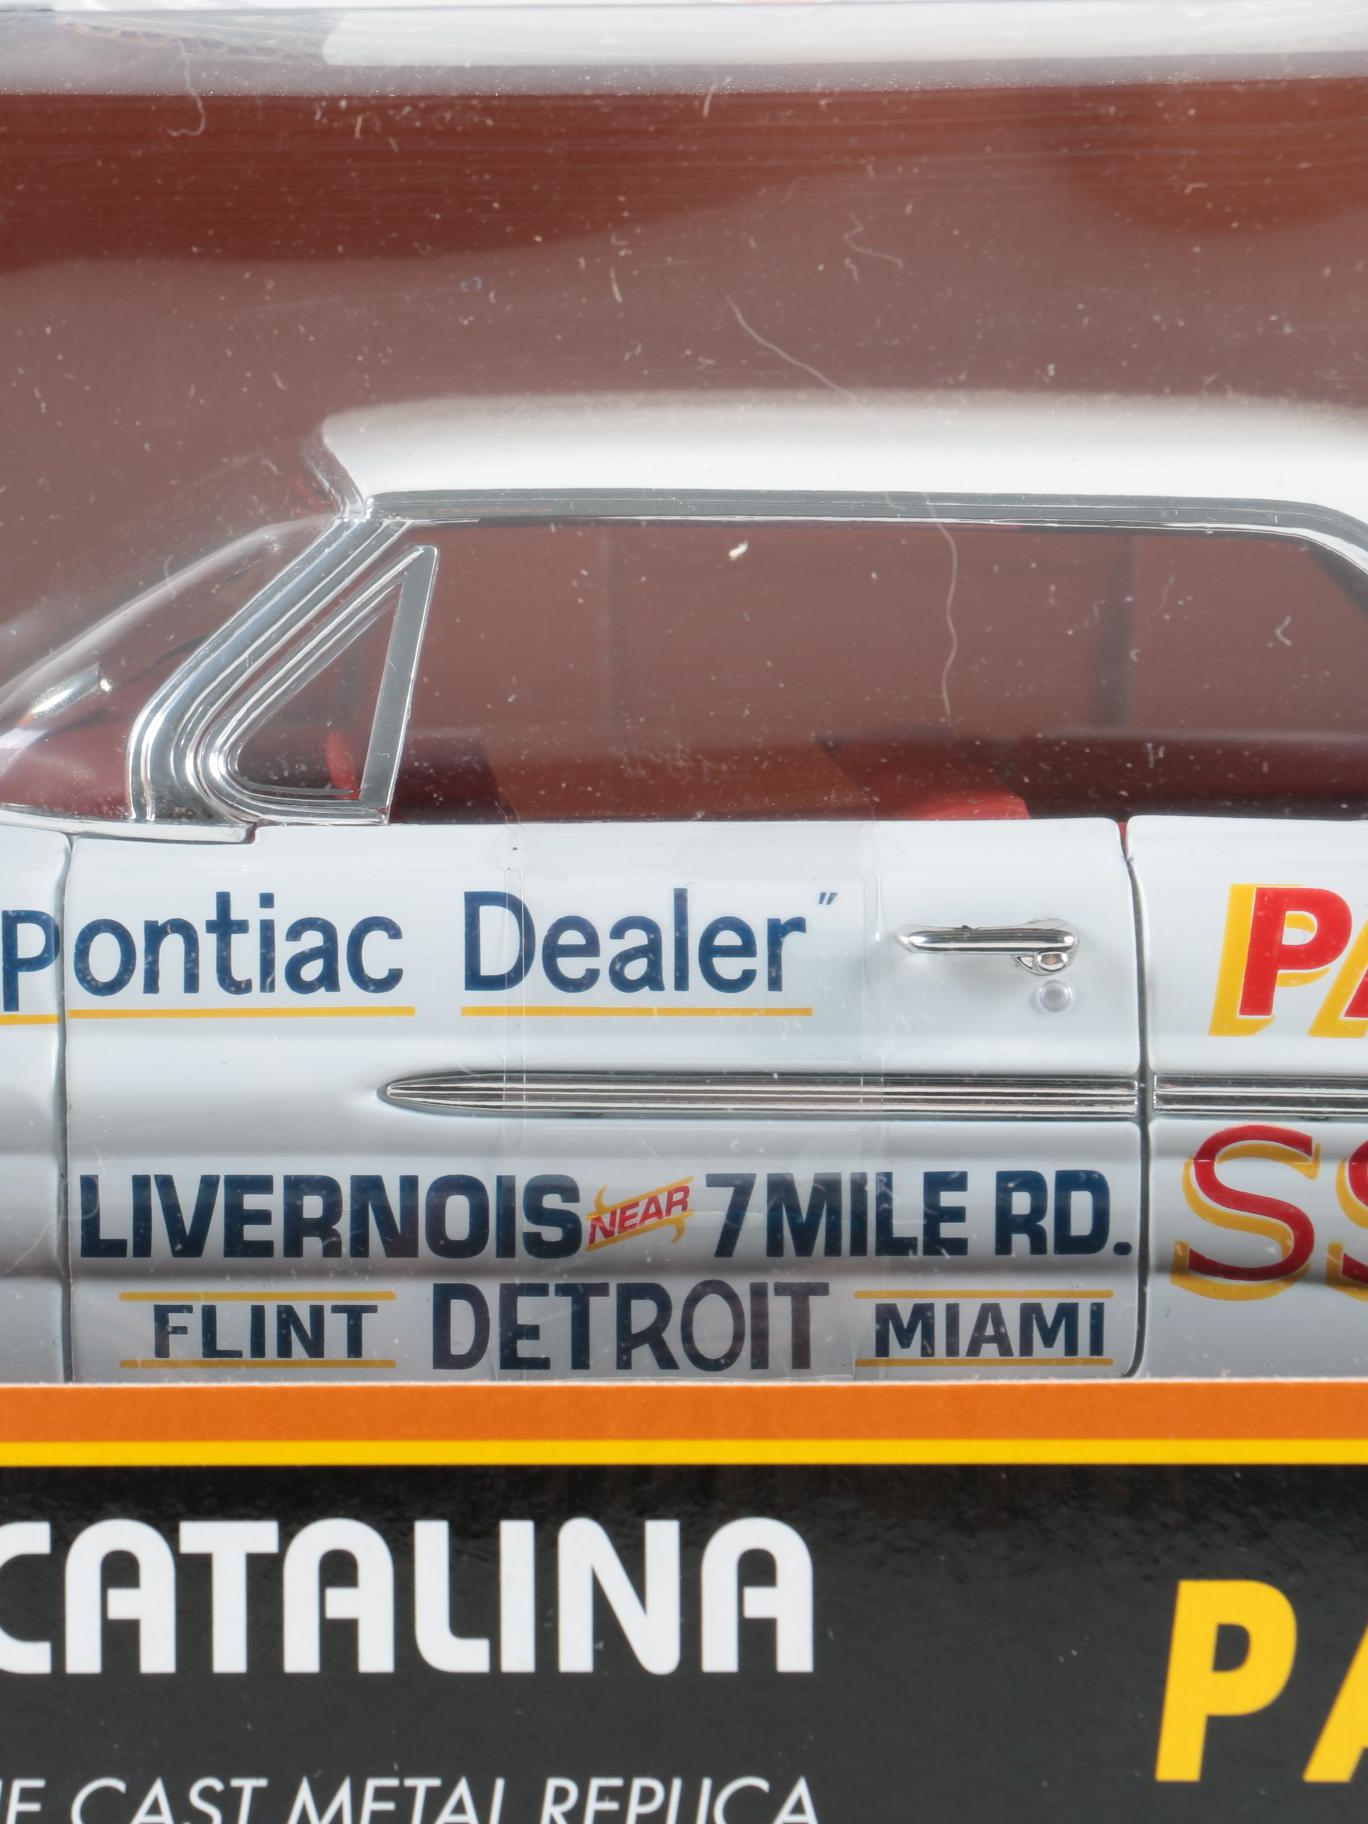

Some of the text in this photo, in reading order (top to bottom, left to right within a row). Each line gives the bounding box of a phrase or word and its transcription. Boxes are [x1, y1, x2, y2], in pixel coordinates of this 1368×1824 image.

[0, 890, 404, 1012] Pontiac
[79, 1174, 583, 1259] LIVERNOIS
[587, 1184, 691, 1246] NEAR
[994, 1169, 1134, 1256] RD.
[153, 1279, 1105, 1372] FLINT DETROIT MIAMI
[70, 1777, 268, 1824] CAST
